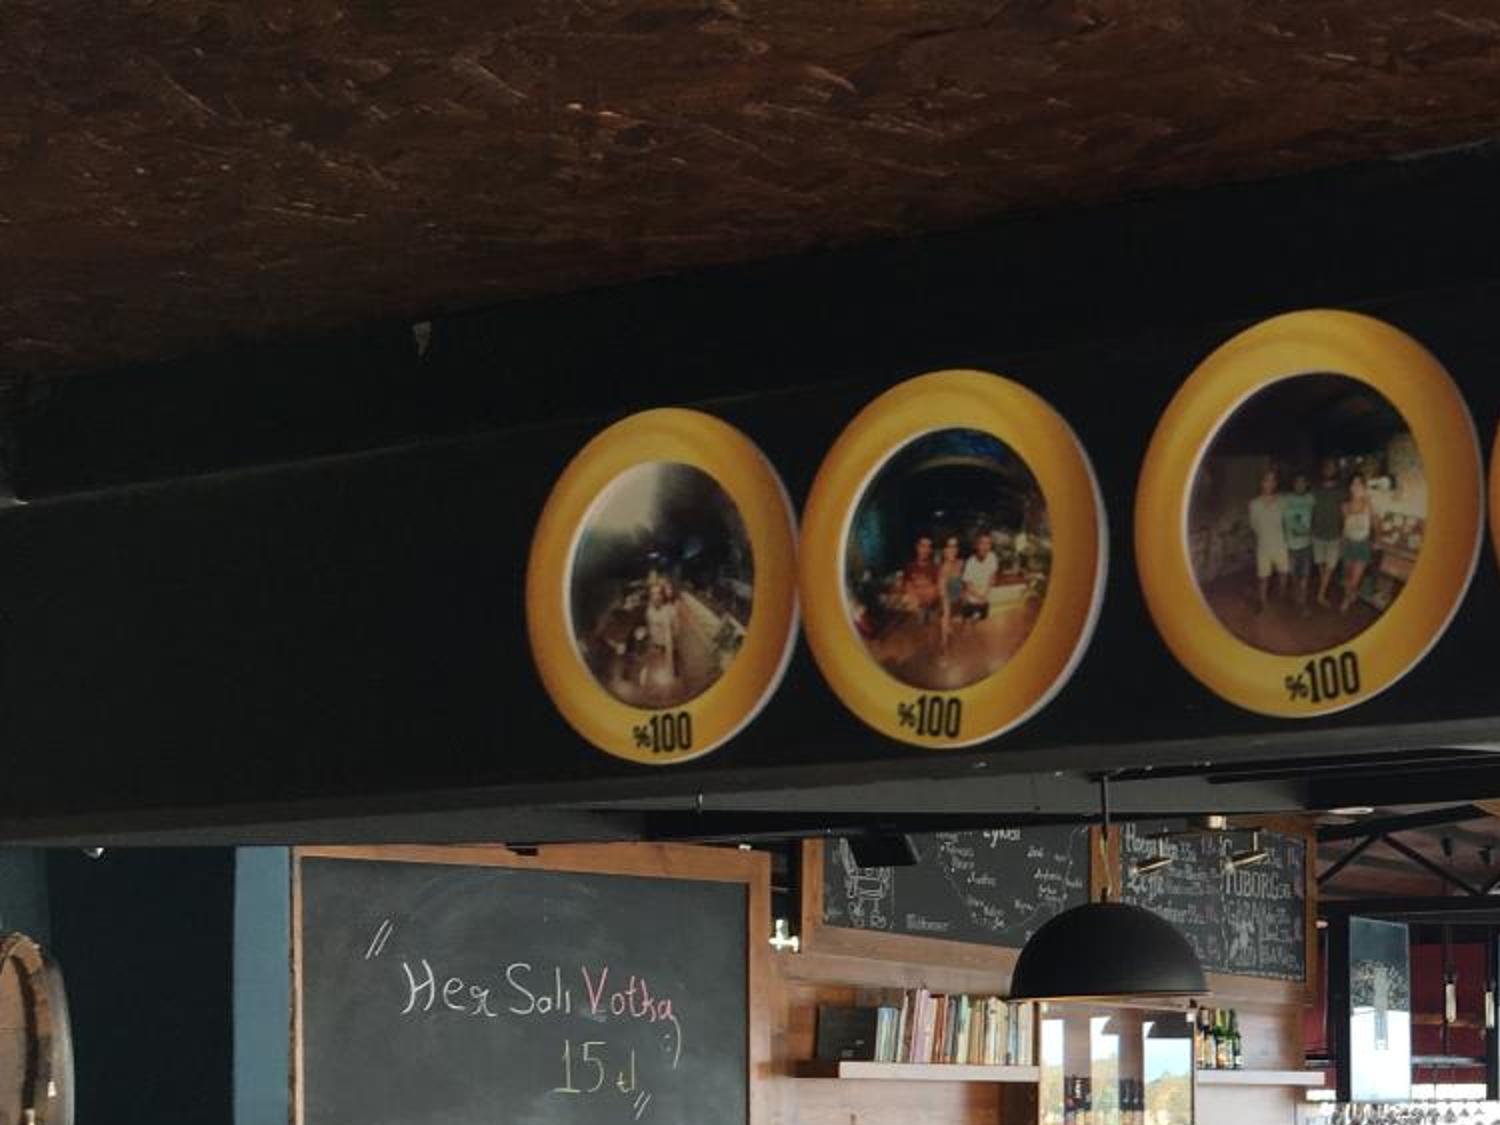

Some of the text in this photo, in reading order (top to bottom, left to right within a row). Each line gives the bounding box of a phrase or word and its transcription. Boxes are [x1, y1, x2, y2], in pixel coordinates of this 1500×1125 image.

[1285, 650, 1361, 704] %100
[633, 711, 693, 753] %100
[897, 695, 963, 740] %100
[553, 1039, 608, 1093] 15
